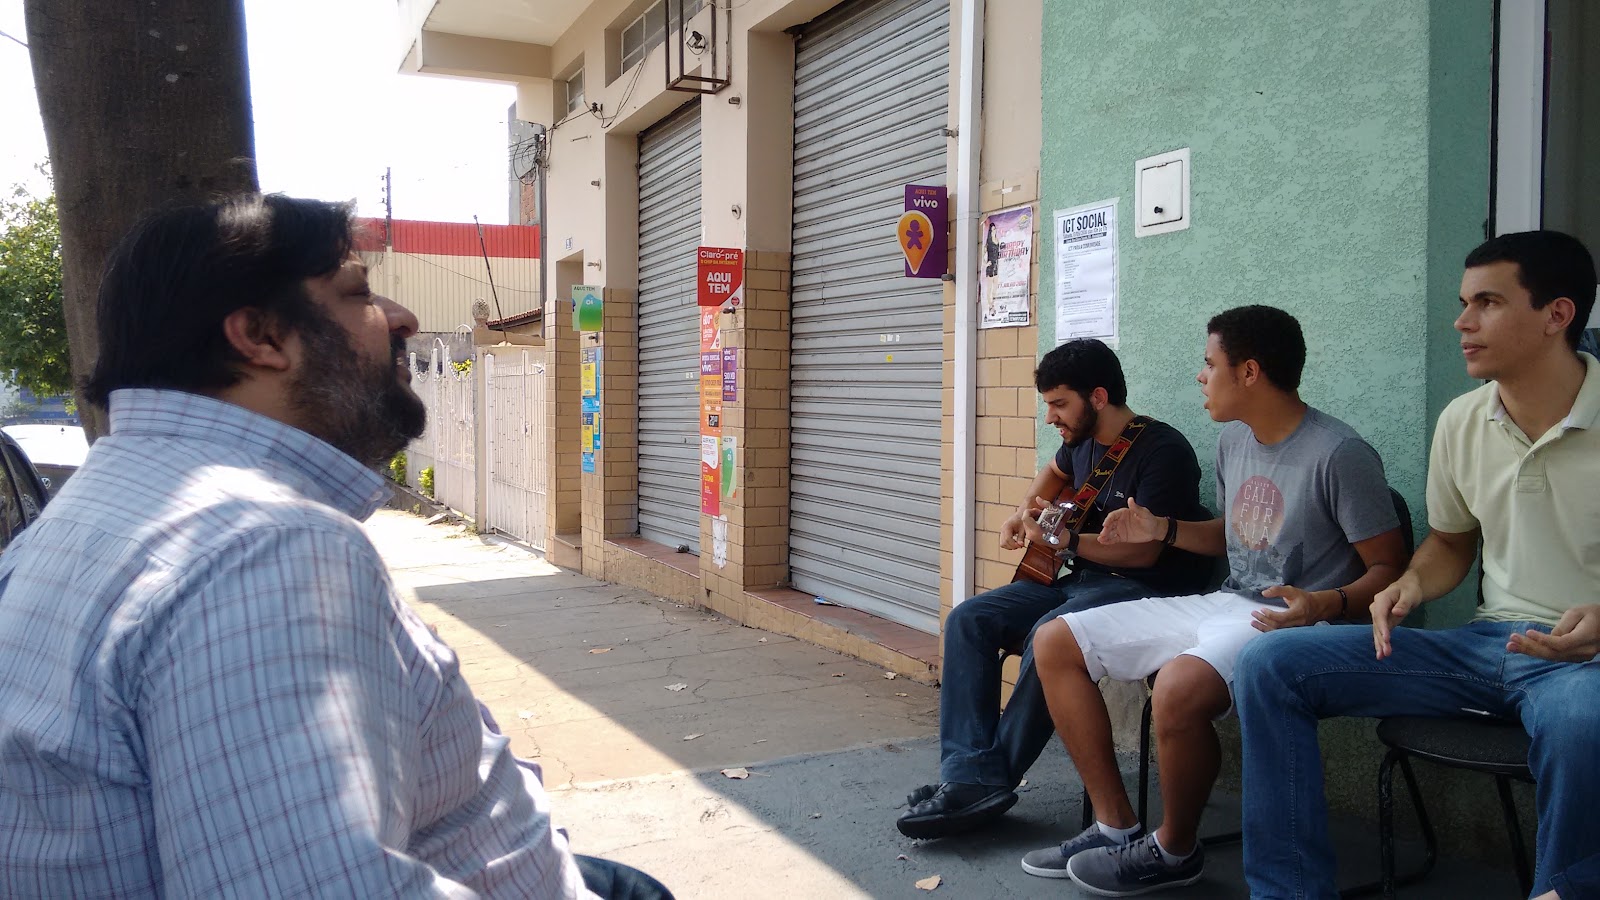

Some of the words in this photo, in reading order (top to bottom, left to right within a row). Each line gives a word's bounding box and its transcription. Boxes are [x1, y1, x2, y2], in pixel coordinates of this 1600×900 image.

[913, 195, 938, 208] vivo
[1062, 217, 1075, 234] ICT
[1076, 211, 1107, 231] SOCIAL
[707, 272, 731, 282] AQUI
[708, 283, 730, 293] TEM
[1244, 484, 1276, 505] CALI
[1240, 502, 1273, 524] FOR
